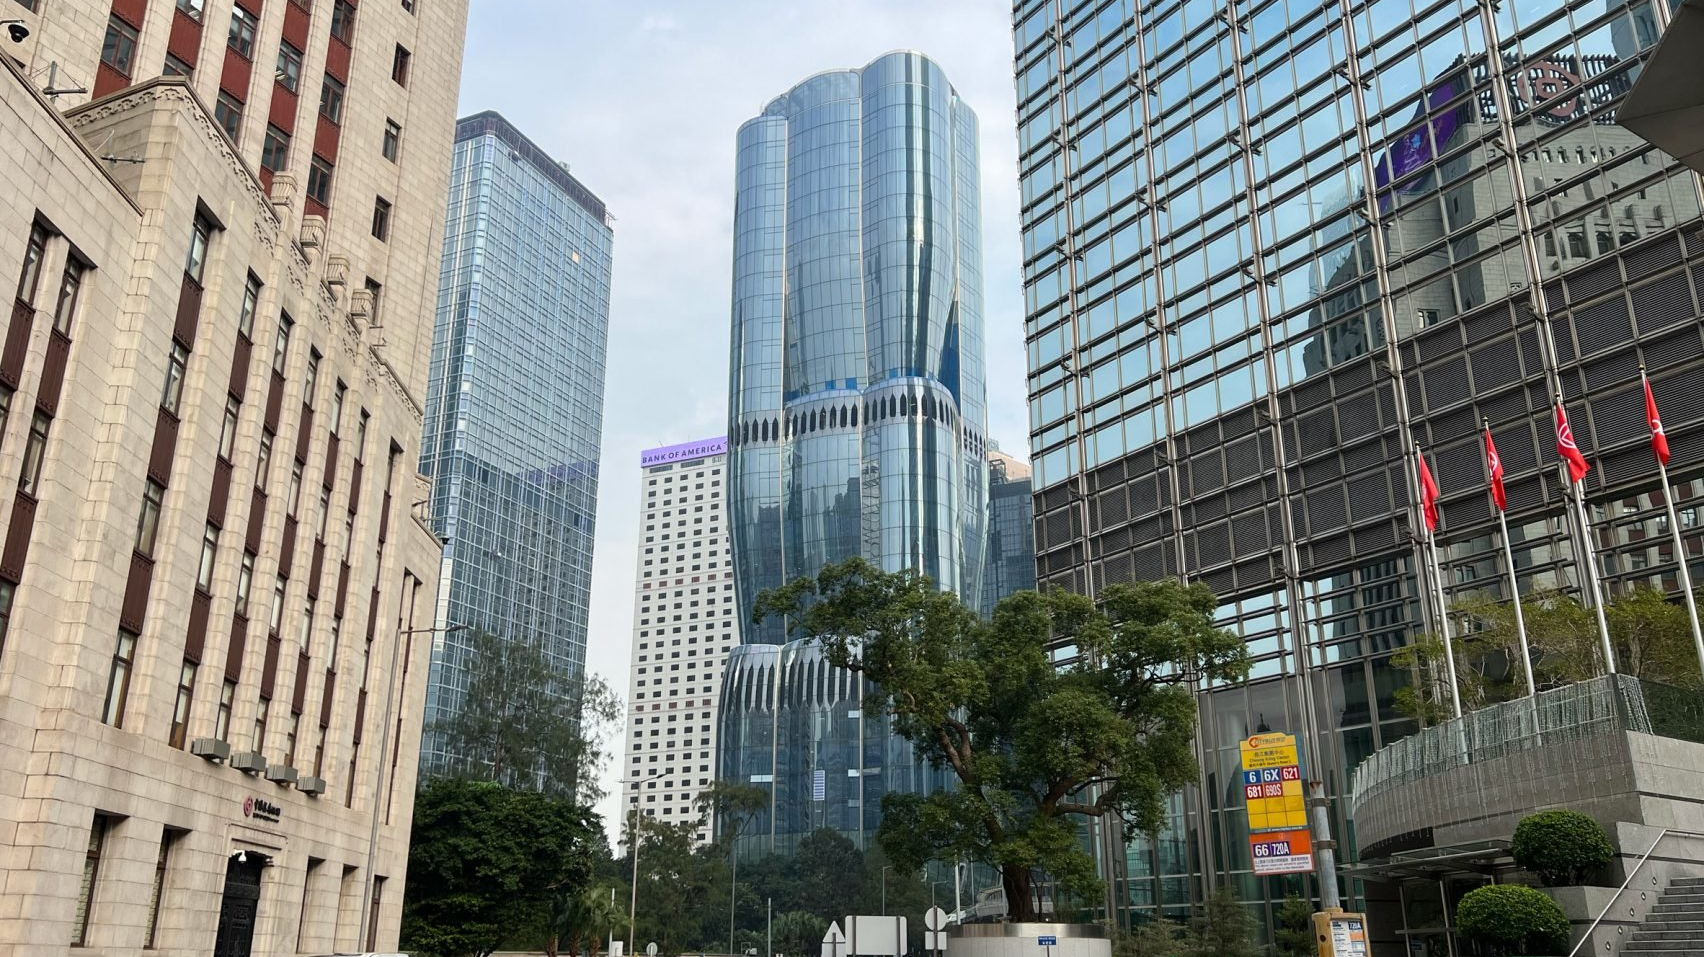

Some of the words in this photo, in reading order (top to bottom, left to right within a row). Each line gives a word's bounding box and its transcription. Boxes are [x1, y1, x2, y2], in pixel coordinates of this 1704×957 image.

[642, 454, 666, 464] BANK
[668, 451, 680, 459] OF
[681, 444, 722, 457] AMERICA
[1250, 771, 1257, 783] 6
[1264, 769, 1280, 781] 6X
[1283, 767, 1298, 779] 621
[1247, 786, 1262, 798] 681
[1265, 784, 1282, 796] 690S
[1255, 844, 1269, 857] 66
[1271, 842, 1290, 855] 720A
